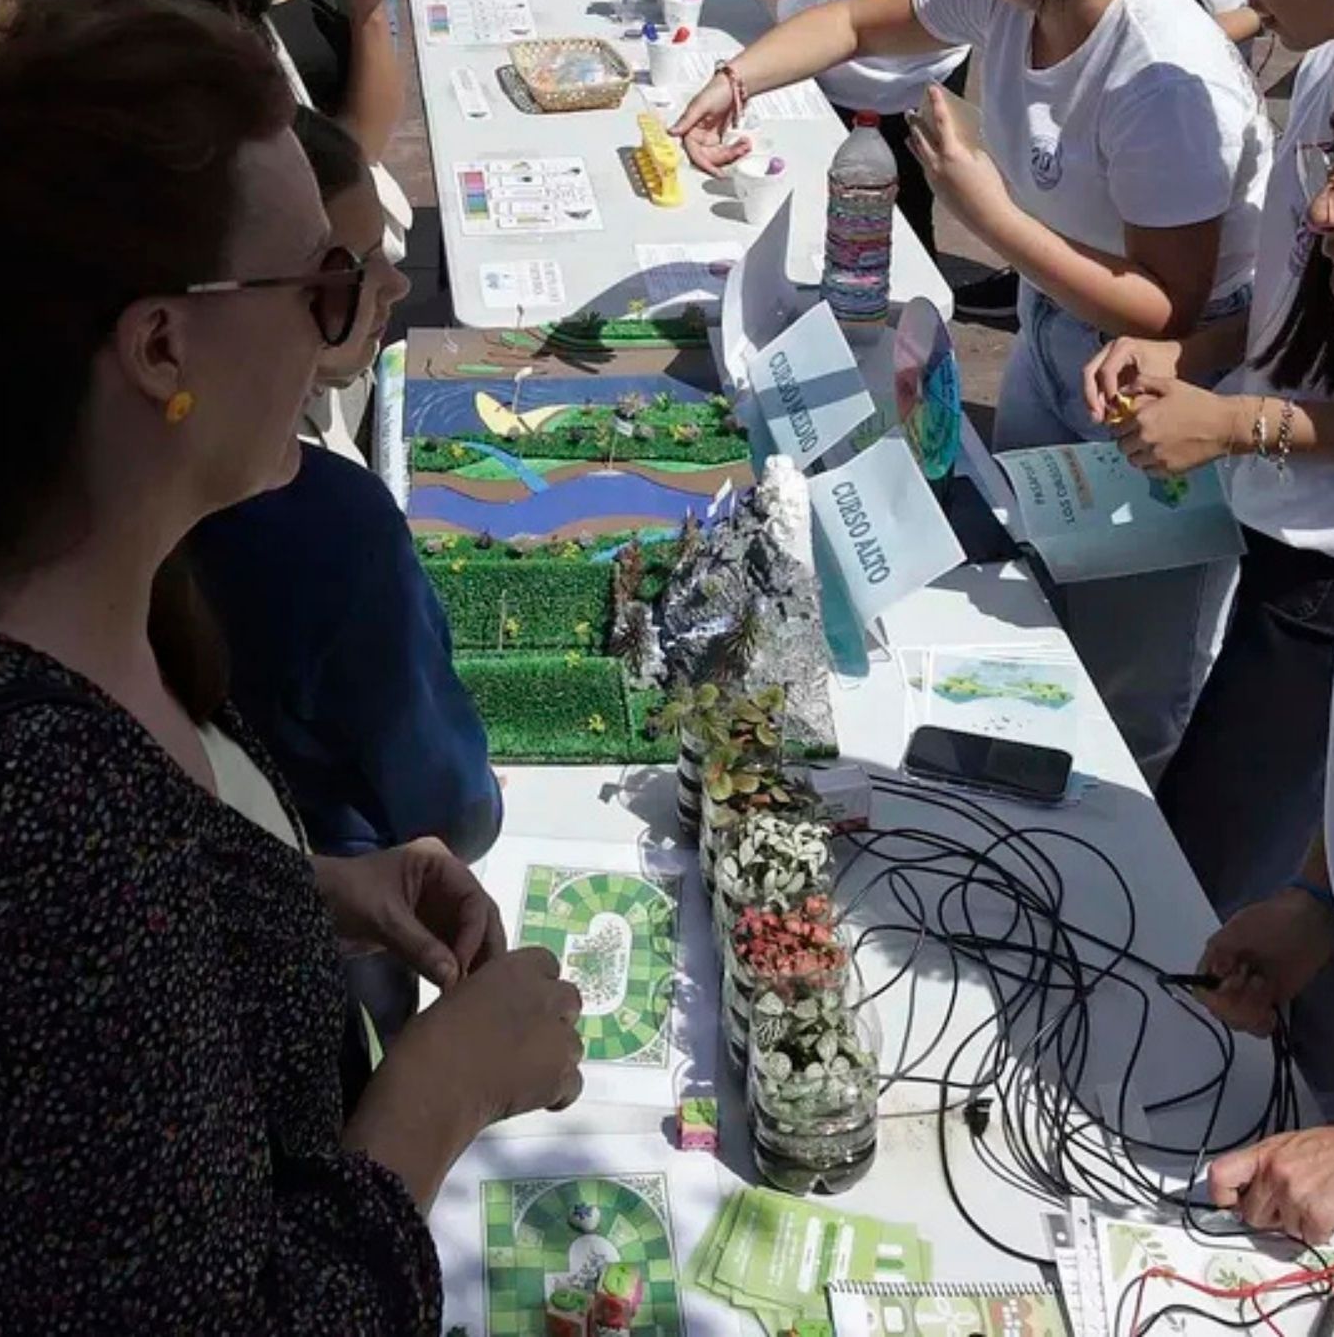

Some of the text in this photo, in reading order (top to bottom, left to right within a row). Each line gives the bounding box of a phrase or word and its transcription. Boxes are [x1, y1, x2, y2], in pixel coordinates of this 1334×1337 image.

[768, 350, 818, 454] CURSO MEDIO
[831, 480, 891, 586] CURSO ALTO
